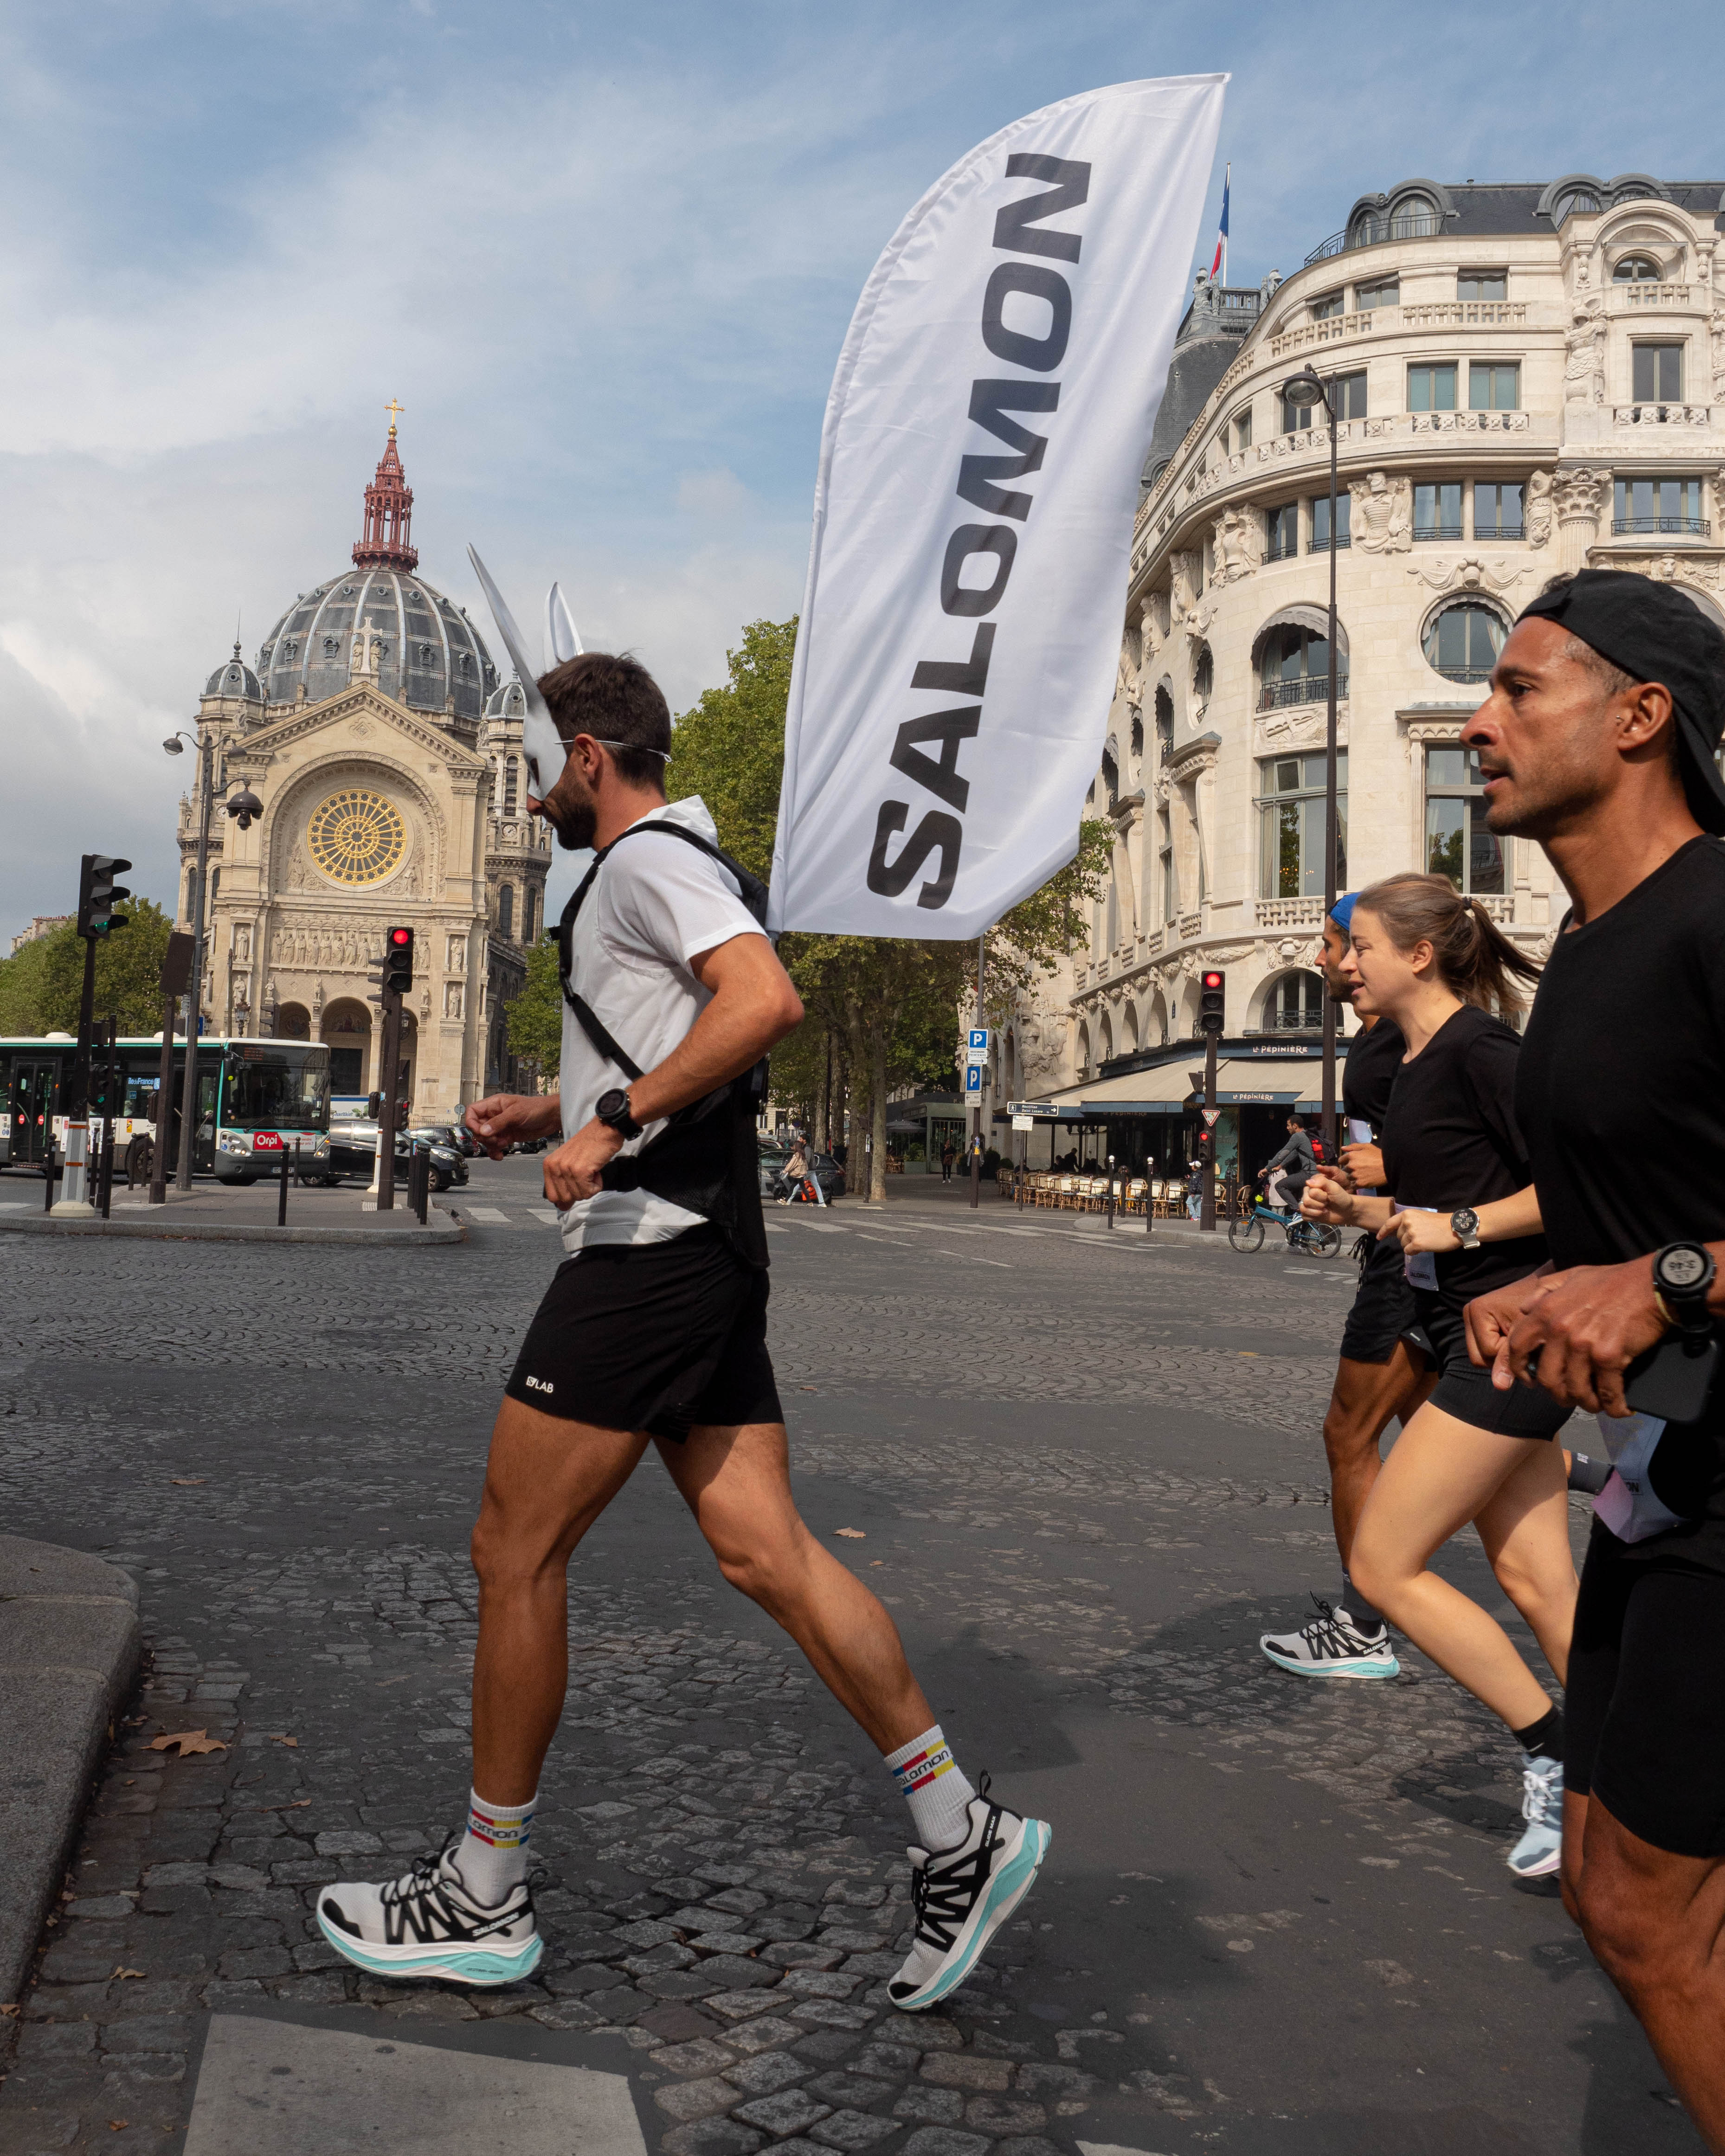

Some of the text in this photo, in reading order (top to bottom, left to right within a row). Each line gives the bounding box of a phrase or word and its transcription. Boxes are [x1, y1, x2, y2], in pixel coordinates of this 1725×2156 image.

[866, 153, 1091, 910] SALOMON
[973, 1033, 983, 1045] P
[970, 1070, 978, 1087] P
[257, 1134, 277, 1147] Orpi
[1363, 1641, 1386, 1654] SALOMON
